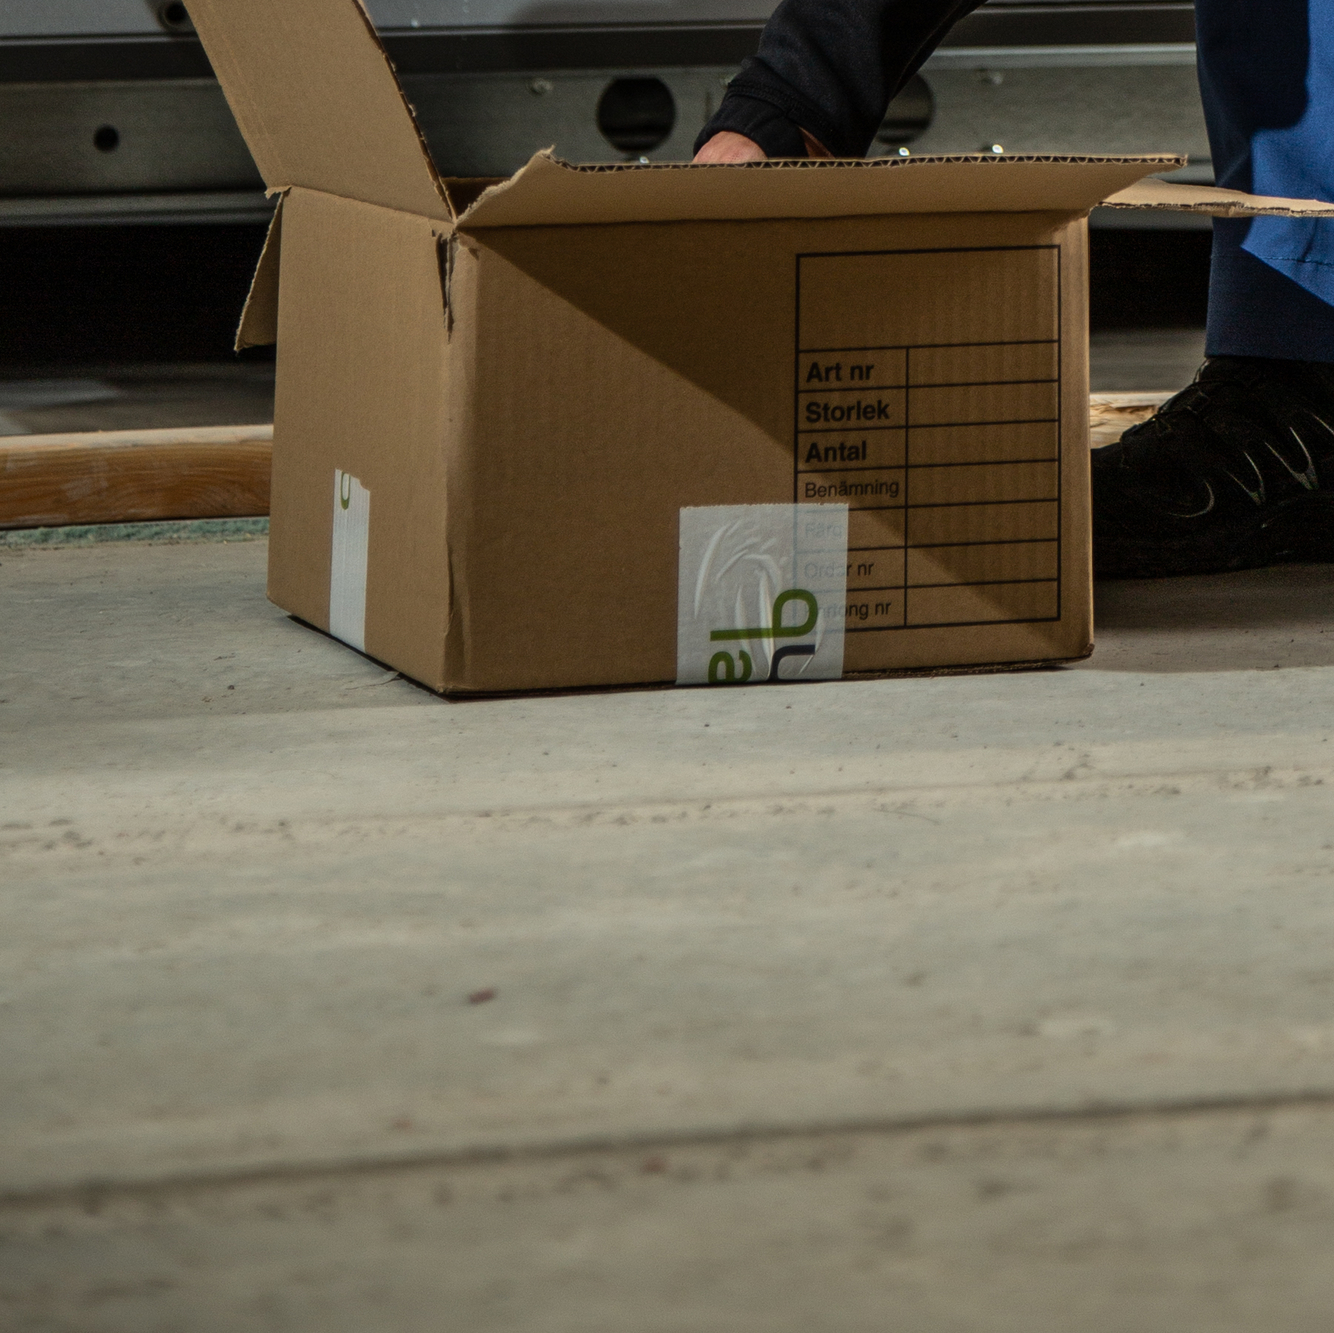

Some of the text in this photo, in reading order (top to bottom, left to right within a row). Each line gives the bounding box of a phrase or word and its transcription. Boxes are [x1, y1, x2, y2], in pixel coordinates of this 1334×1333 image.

[806, 362, 874, 383] Art nr
[806, 400, 889, 423] Storlek
[805, 440, 867, 463] Antal
[805, 480, 899, 498] Benämning
[857, 563, 875, 576] nr
[875, 602, 891, 616] nr
